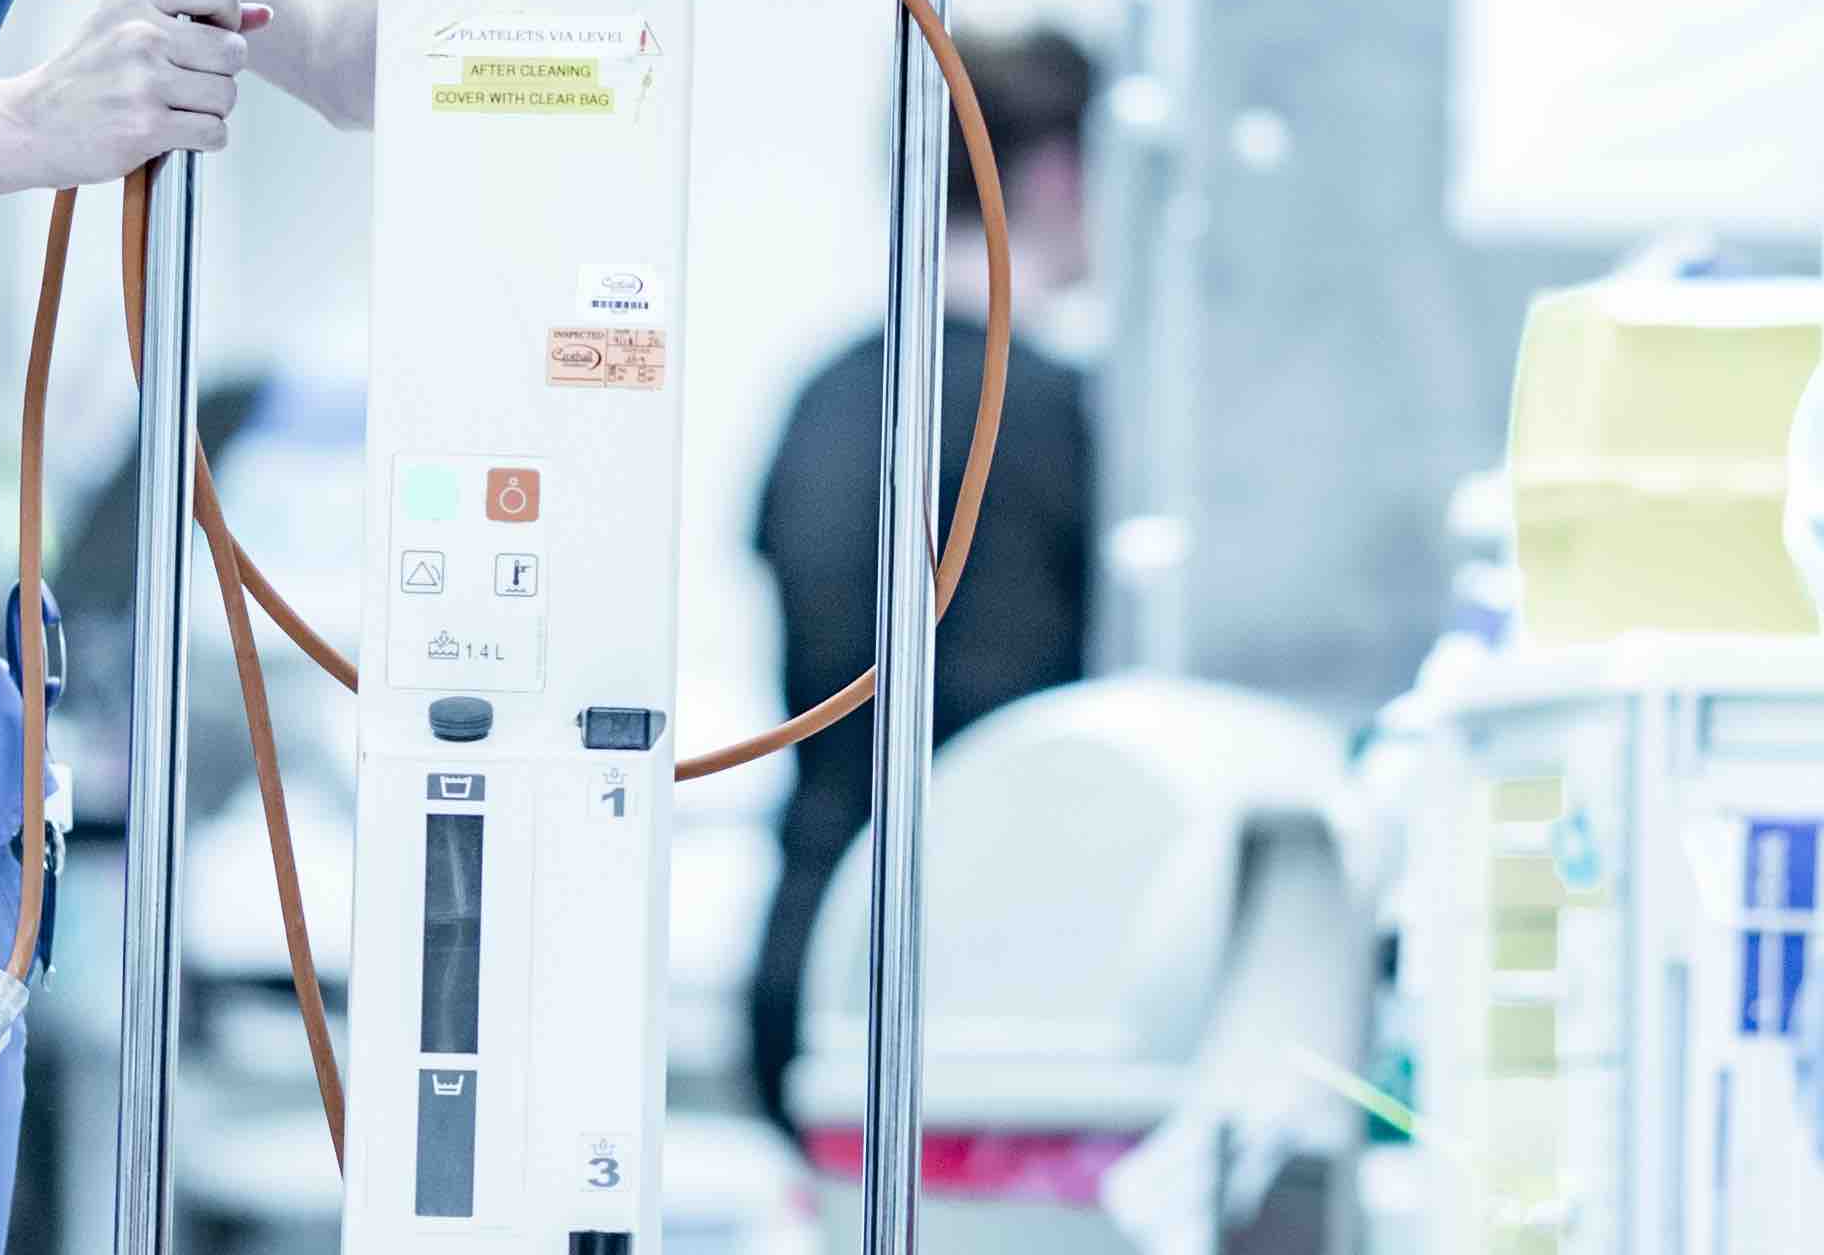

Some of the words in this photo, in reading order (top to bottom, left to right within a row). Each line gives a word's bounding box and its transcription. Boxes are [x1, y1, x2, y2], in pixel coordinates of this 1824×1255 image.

[460, 29, 544, 41] PLATELETS
[549, 30, 573, 42] VIA
[578, 30, 624, 43] LEVEL
[470, 63, 516, 77] AFTER
[520, 63, 592, 78] CLEANING
[435, 90, 484, 105] COVER
[489, 91, 525, 105] WITH
[529, 92, 576, 105] CLEAR
[579, 93, 609, 107] BAG
[601, 787, 625, 817] 1
[587, 1157, 620, 1188] 3
